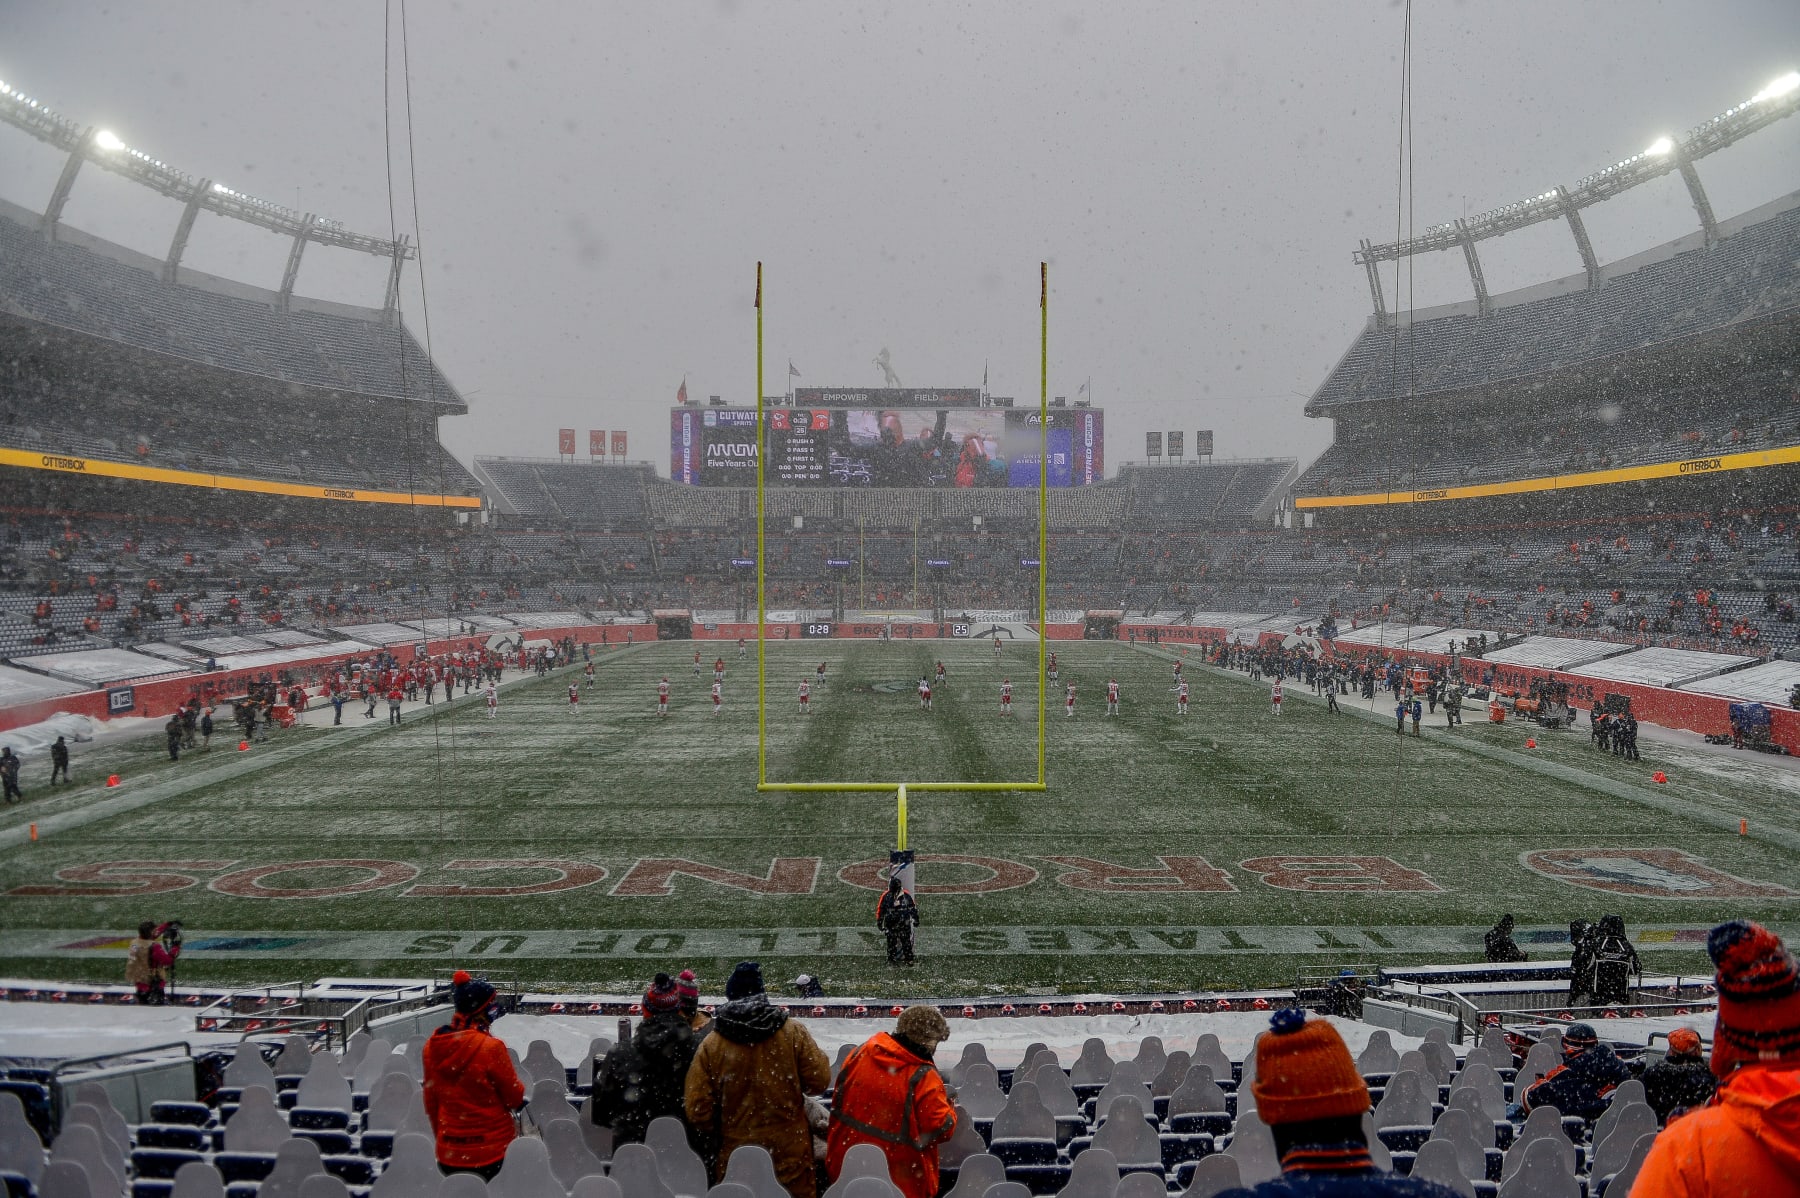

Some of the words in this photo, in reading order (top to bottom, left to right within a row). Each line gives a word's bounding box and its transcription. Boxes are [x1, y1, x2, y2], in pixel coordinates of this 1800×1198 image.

[42, 455, 85, 471] OTTERBOX
[725, 460, 746, 468] Years
[1680, 458, 1721, 473] OTTERBOX
[323, 489, 354, 499] OTTERBOX
[1416, 490, 1448, 500] OTTERBOX
[809, 624, 829, 634] 0:28
[954, 625, 968, 634] 25
[2, 855, 1446, 898] BRONCOS
[402, 935, 528, 955] US
[570, 933, 687, 955] OF
[960, 929, 1265, 951] TAKES
[1314, 929, 1396, 950] IT
